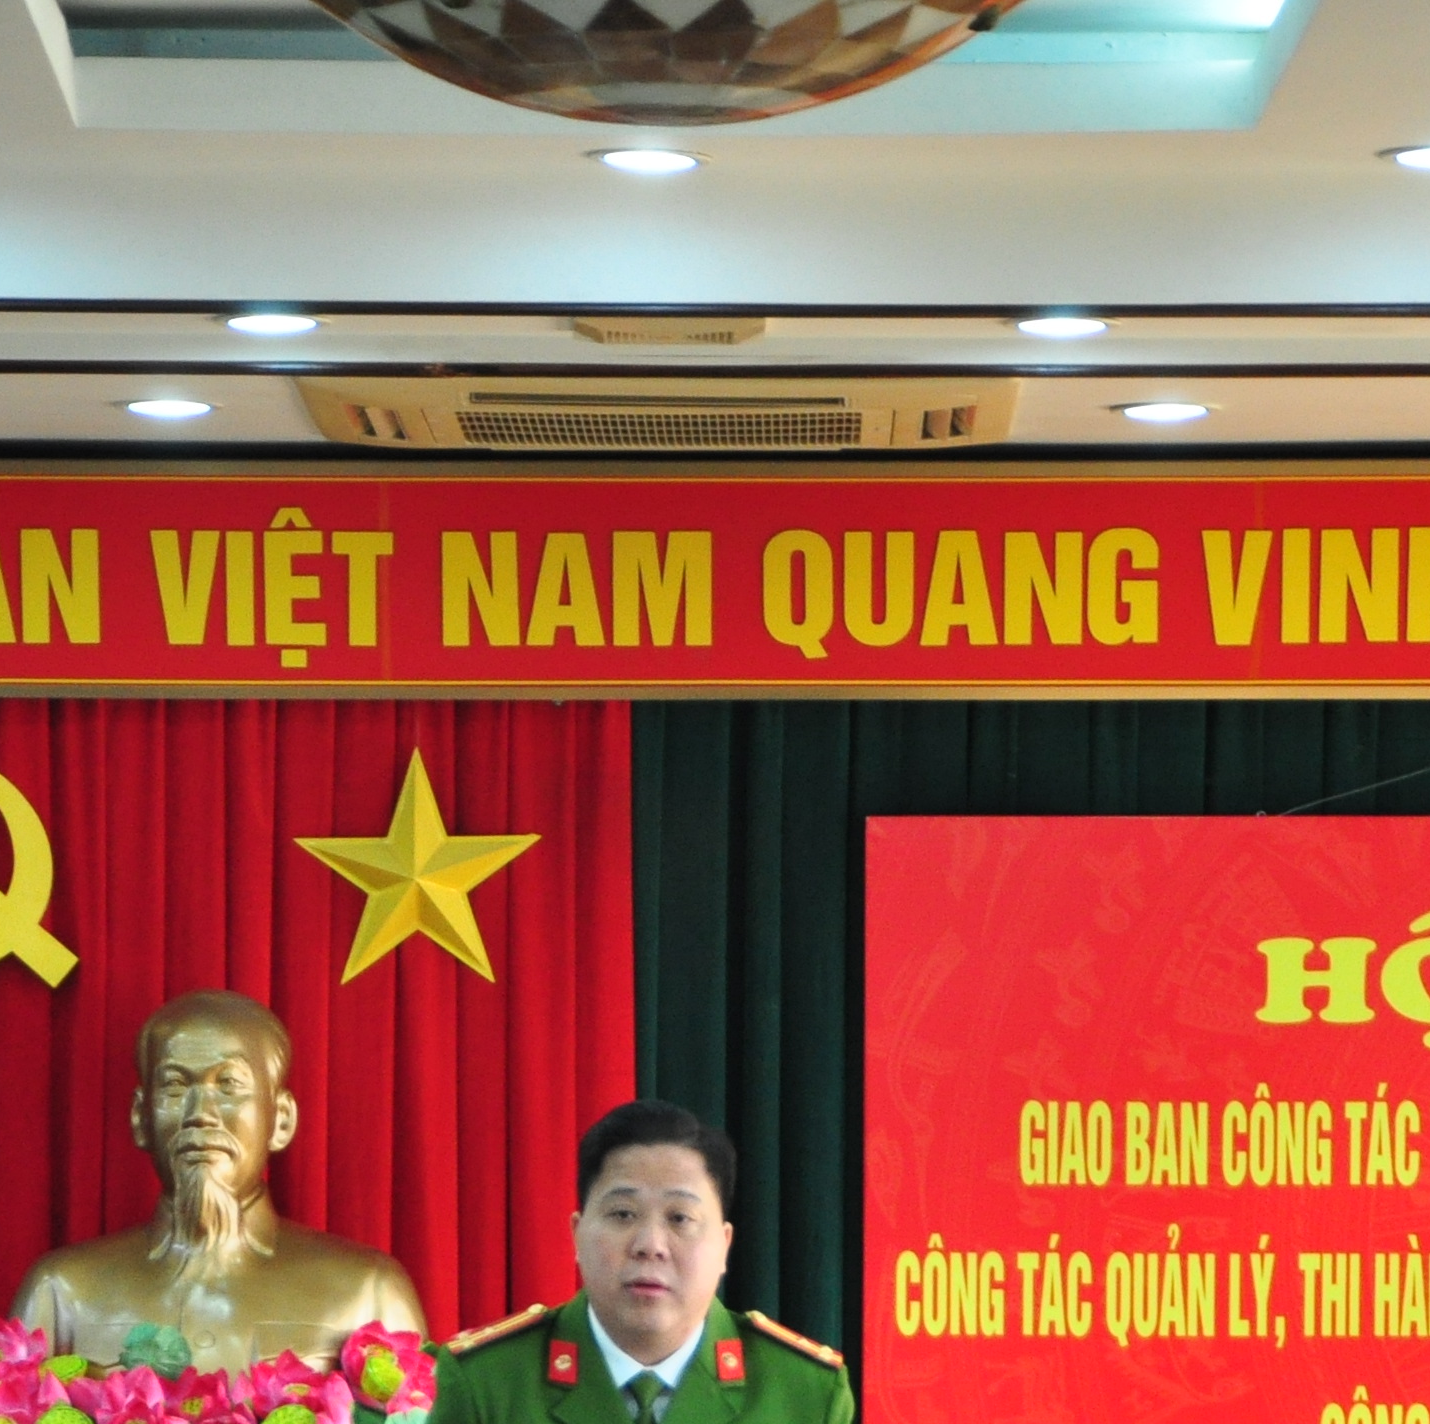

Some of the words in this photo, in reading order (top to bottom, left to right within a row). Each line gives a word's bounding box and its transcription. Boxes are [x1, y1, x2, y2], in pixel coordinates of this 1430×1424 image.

[150, 507, 394, 667] VIỆT
[441, 531, 713, 646] NAM
[762, 527, 1159, 659] QUANG
[1019, 1101, 1113, 1187] GIAO
[1125, 1101, 1209, 1186] BAN
[1221, 1083, 1332, 1187] CÔNG
[1344, 1083, 1421, 1187] TÁC
[895, 1233, 1005, 1337] CÔNG
[1016, 1233, 1093, 1338] TÁC
[1105, 1223, 1216, 1348] QUẢN
[1228, 1234, 1286, 1348] LÝ,
[1298, 1252, 1361, 1337] THI
